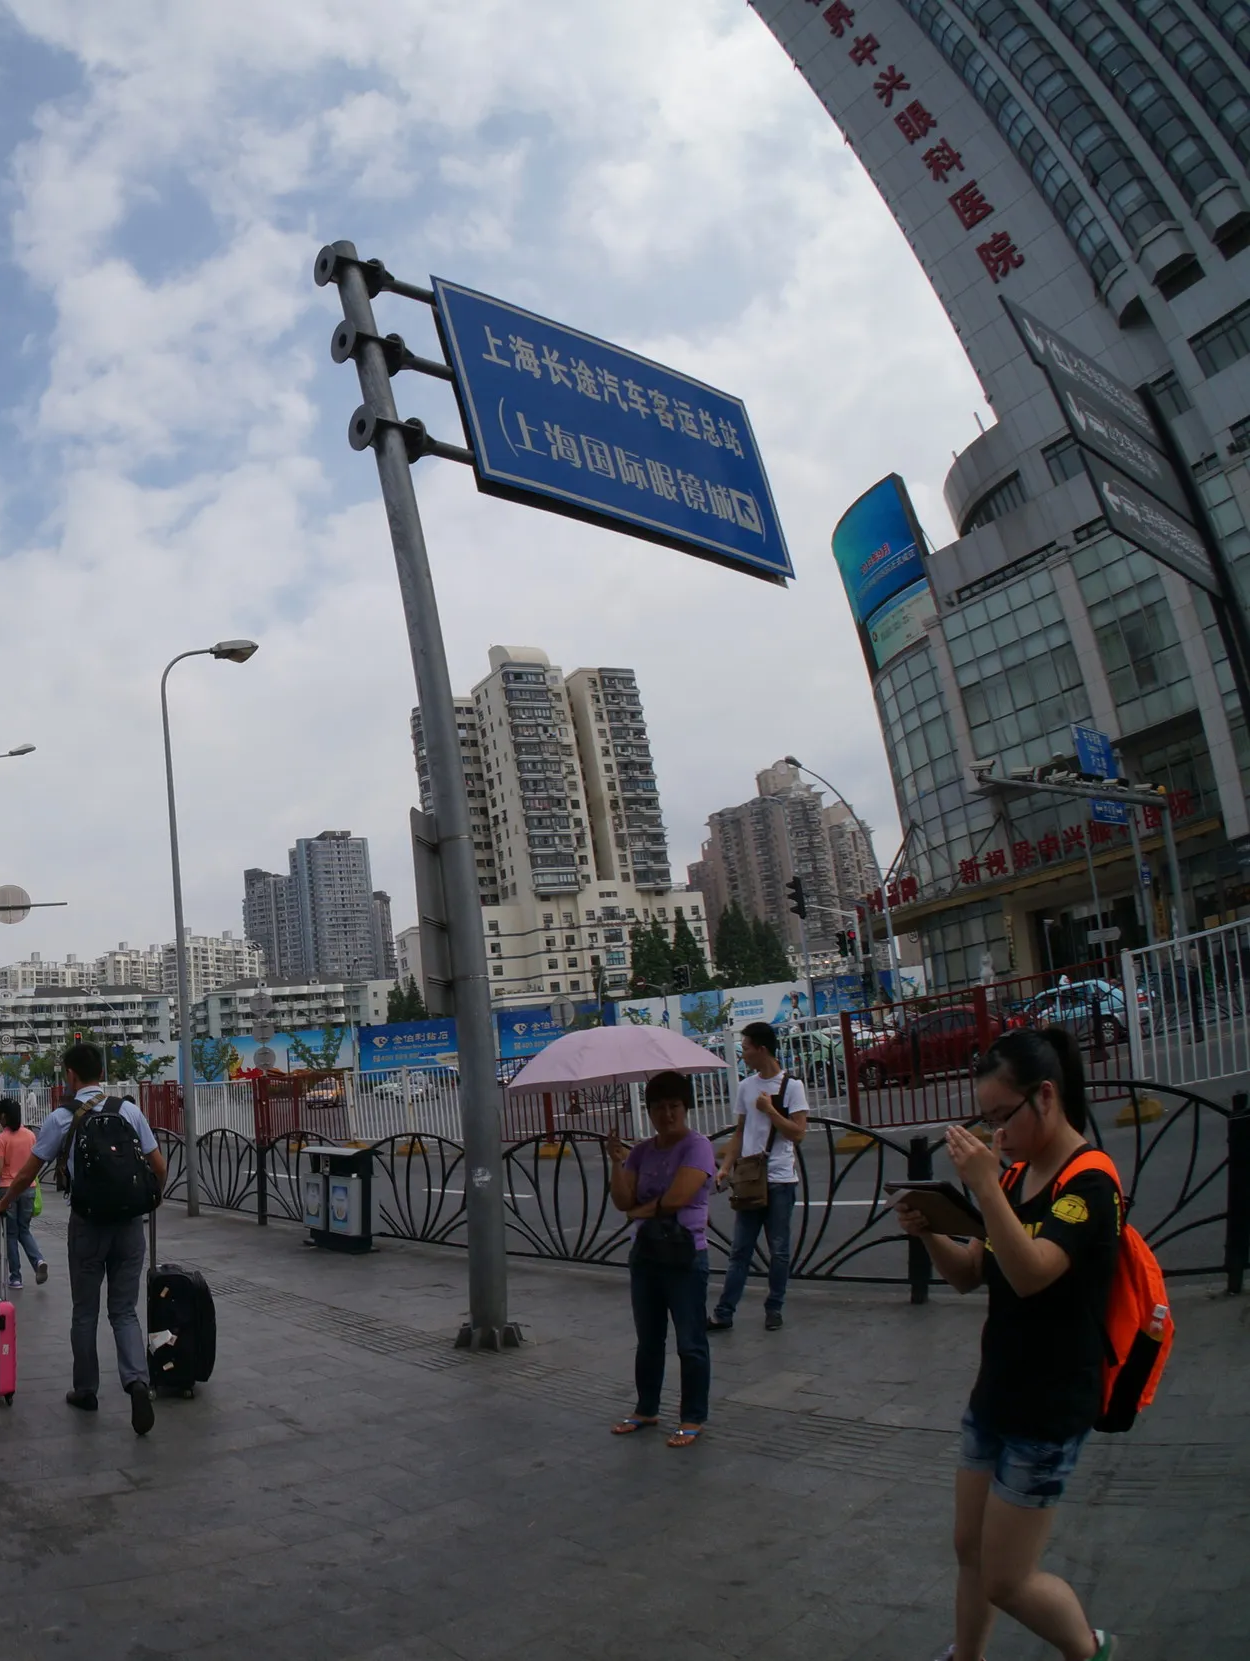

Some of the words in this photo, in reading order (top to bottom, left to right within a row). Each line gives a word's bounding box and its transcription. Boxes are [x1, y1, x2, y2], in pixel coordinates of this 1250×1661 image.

[481, 324, 745, 459] 上海长途汽车客运总站
